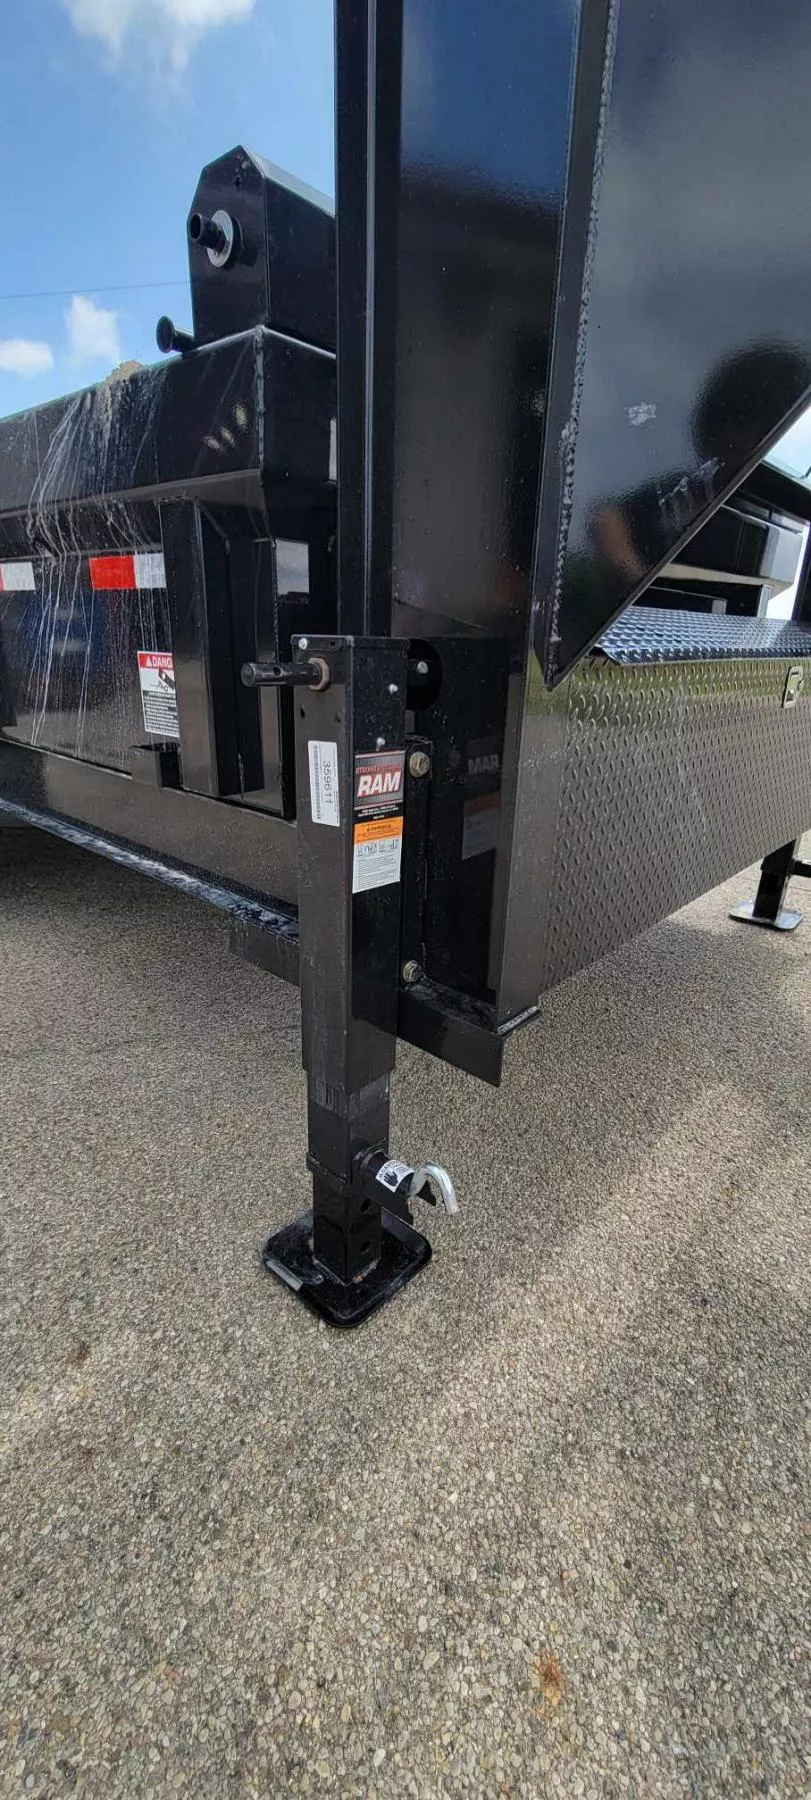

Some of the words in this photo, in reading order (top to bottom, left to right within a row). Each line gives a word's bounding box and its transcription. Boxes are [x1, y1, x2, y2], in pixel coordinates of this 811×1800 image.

[152, 656, 173, 669] DANG
[323, 760, 332, 804] 359611
[357, 772, 401, 798] RAM
